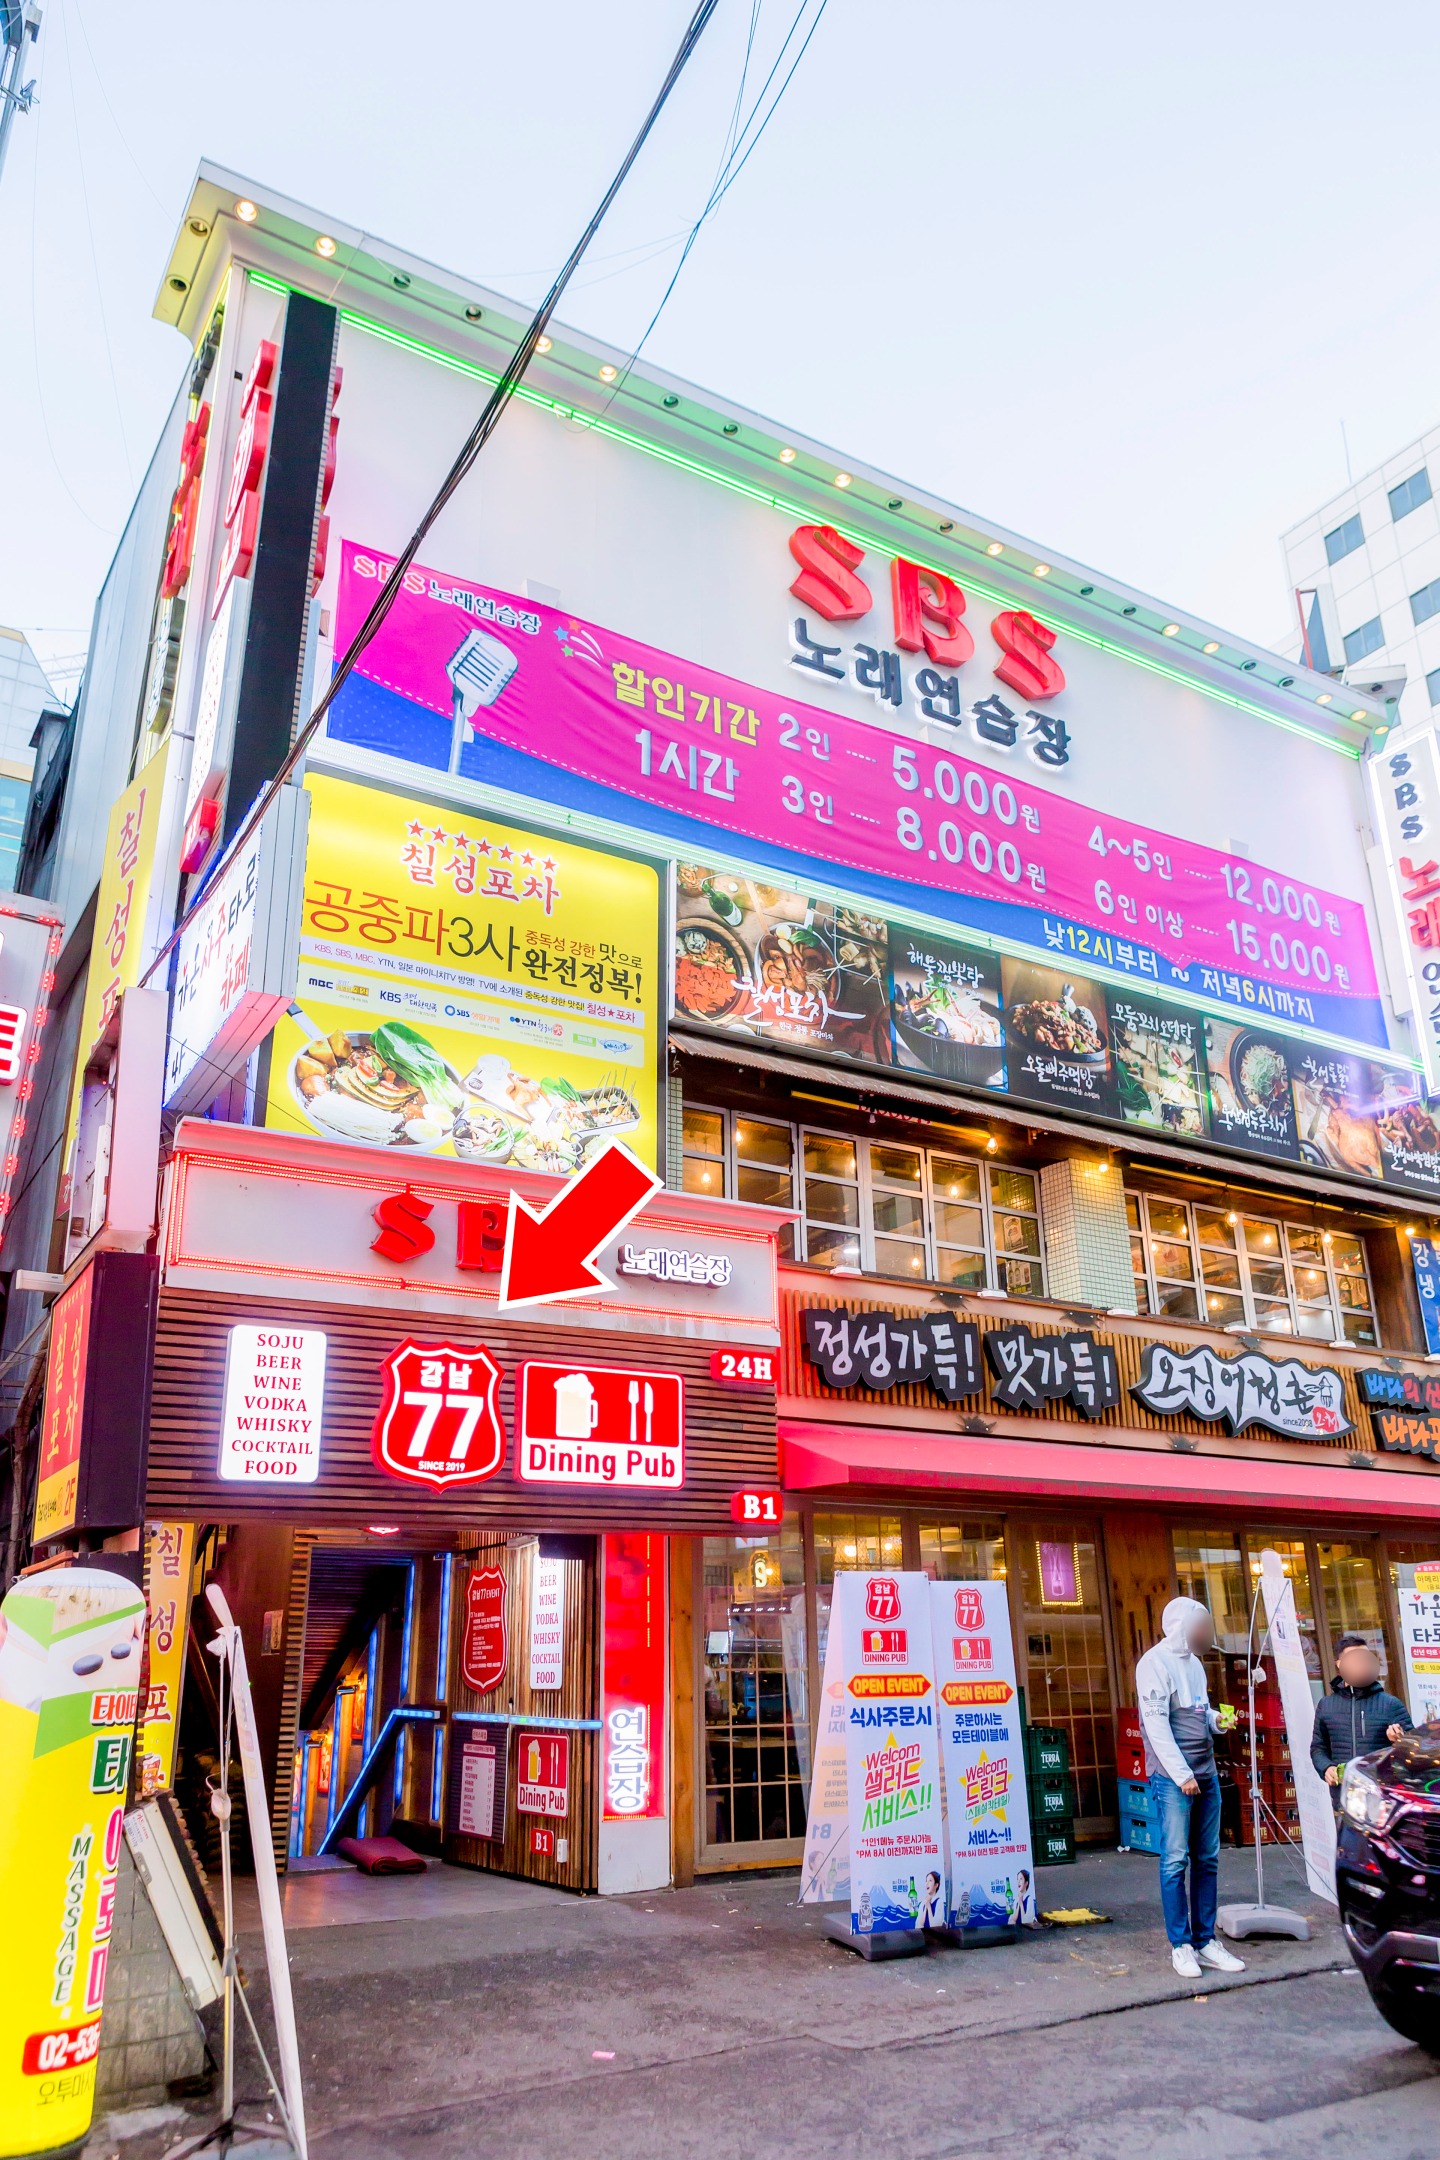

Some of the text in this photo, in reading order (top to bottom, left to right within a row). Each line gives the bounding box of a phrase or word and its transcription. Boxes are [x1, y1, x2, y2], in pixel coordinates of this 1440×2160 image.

[429, 580, 542, 636] 노래연습장
[789, 525, 1067, 702] SBS
[612, 660, 761, 747] 할인기간
[787, 616, 1072, 769] 노래연습장
[635, 728, 741, 803] 1시간
[778, 712, 1042, 835] 2인 5.000원
[781, 775, 1047, 894] 3인 8.000원
[401, 841, 561, 917] 칠성포차
[1088, 825, 1343, 938] 4~5인 12.000원
[305, 879, 521, 973] 공중파3사
[1094, 879, 1352, 992] 6인 이상 15.000원
[524, 929, 644, 970] 중독성 강한 맛으로
[521, 948, 643, 1004] 완전정복!
[379, 989, 402, 1004] KBS
[1201, 970, 1316, 1024] 저녁6시까지
[626, 1244, 732, 1286] 노래연습장
[256, 1333, 304, 1350] SOJU
[256, 1354, 302, 1370] BEER
[720, 1354, 773, 1381] 24H
[814, 1319, 1112, 1406] 정성가득! 맛가득!
[253, 1374, 302, 1391] WINE
[420, 1359, 473, 1390] 강남
[244, 1395, 308, 1412] VODKA
[236, 1416, 313, 1433] WHISKY
[403, 1391, 484, 1460] 77
[231, 1439, 313, 1455] COCKTAIL
[244, 1460, 298, 1476] FOOD
[417, 1460, 466, 1472] SINCE 2019
[529, 1443, 676, 1482] Dining Pub
[743, 1493, 778, 1520] B1
[539, 1575, 557, 1587] BEER
[539, 1593, 557, 1606] WINE
[872, 1596, 894, 1616] 77
[535, 1612, 559, 1626] VODKA
[959, 1606, 979, 1625] 77
[533, 1631, 561, 1645] WHISKY
[531, 1653, 561, 1665] COCKTAIL
[864, 1653, 906, 1663] DINING PUB
[955, 1659, 992, 1670] DINING PUB
[536, 1671, 556, 1684] FOOD
[853, 1676, 925, 1694] OPEN EVENT
[945, 1685, 1008, 1702] OPEN EVENT
[849, 1705, 932, 1728] 식사주문시
[955, 1712, 1003, 1727] 주문하시는
[952, 1727, 1009, 1744] 모든테이블에
[611, 1710, 647, 1810] 연습장
[865, 1742, 921, 1771] Welcom
[1040, 1750, 1061, 1763] TERRA
[864, 1756, 921, 1801] 샐러드
[965, 1757, 1008, 1781] Welcom
[519, 1786, 565, 1812] Dining Pub
[965, 1770, 1009, 1809] 드링크
[1044, 1793, 1064, 1806] TERRA
[861, 1782, 933, 1833] 서비스!!
[535, 1832, 549, 1852] B1
[1047, 1838, 1067, 1851] TERRA
[54, 1836, 92, 2002] MASSAGE
